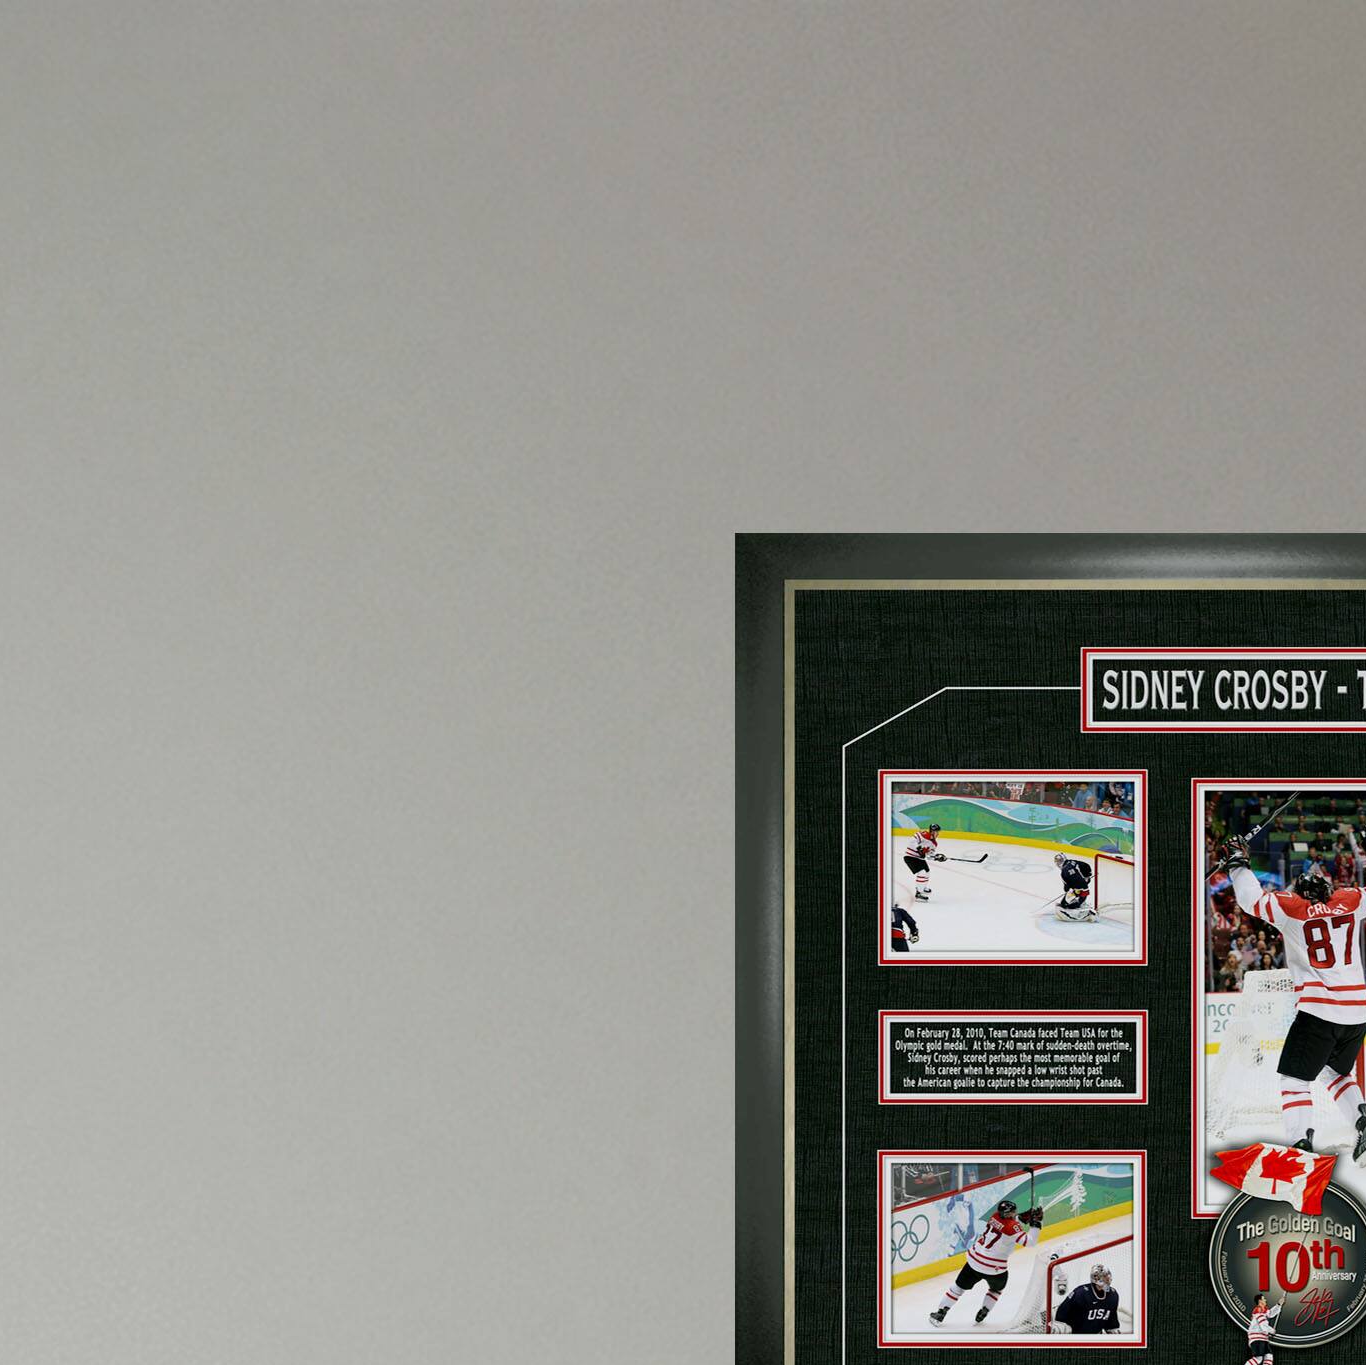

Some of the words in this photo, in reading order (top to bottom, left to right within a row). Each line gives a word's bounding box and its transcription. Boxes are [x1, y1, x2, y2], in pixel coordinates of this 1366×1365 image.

[1102, 669, 1205, 710] SIDNEY
[1214, 669, 1327, 710] CROSBY
[1337, 685, 1348, 694] -
[1303, 913, 1355, 969] 87
[904, 1028, 915, 1038] On
[916, 1028, 950, 1040] February
[952, 1028, 963, 1039] 28,
[966, 1028, 987, 1039] 2010,
[988, 1028, 1009, 1038] Team
[1010, 1028, 1036, 1038] Canada
[1038, 1028, 1058, 1038] faced
[1060, 1028, 1080, 1038] Team
[1081, 1028, 1096, 1038] USA
[1098, 1028, 1109, 1038] for
[1110, 1028, 1123, 1038] the
[895, 1040, 924, 1052] Olympic
[926, 1040, 942, 1052] gold
[943, 1040, 969, 1050] medal.
[972, 1040, 982, 1050] At
[983, 1040, 996, 1050] the
[998, 1040, 1015, 1050] 7:40
[1016, 1040, 1035, 1050] mark
[1036, 1040, 1045, 1050] of
[1046, 1040, 1095, 1050] sudden-death
[1096, 1040, 1132, 1052] overtime,
[907, 1052, 932, 1065] Sidney
[933, 1052, 961, 1065] Crosby,
[962, 1052, 986, 1062] scored
[988, 1052, 1017, 1065] perhaps
[1019, 1052, 1032, 1062] the
[1034, 1053, 1052, 1062] most
[1053, 1052, 1093, 1062] memorable
[1095, 1052, 1110, 1065] goal
[1111, 1052, 1120, 1062] of
[924, 1064, 936, 1074] his
[937, 1066, 961, 1075] career
[963, 1064, 983, 1074] when
[984, 1064, 995, 1075] he
[996, 1064, 1026, 1077] snapped
[1027, 1067, 1033, 1075] a
[1034, 1064, 1047, 1074] low
[1048, 1065, 1068, 1075] wrist
[1069, 1064, 1086, 1075] shot
[1087, 1065, 1103, 1077] past
[903, 1077, 916, 1087] the
[917, 1077, 952, 1087] American
[952, 1077, 976, 1089] goalie
[977, 1077, 986, 1087] to
[986, 1078, 1016, 1089] capture
[1017, 1077, 1030, 1087] the
[1031, 1077, 1081, 1089] championship
[1082, 1077, 1094, 1087] for
[1095, 1077, 1125, 1087] Canada.
[1236, 1221, 1265, 1242] The
[1268, 1215, 1320, 1234] Golden
[1324, 1216, 1356, 1243] Goal
[1246, 1238, 1345, 1293] 10th
[1311, 1271, 1357, 1283] Anniversary
[1087, 1308, 1111, 1320] USA
